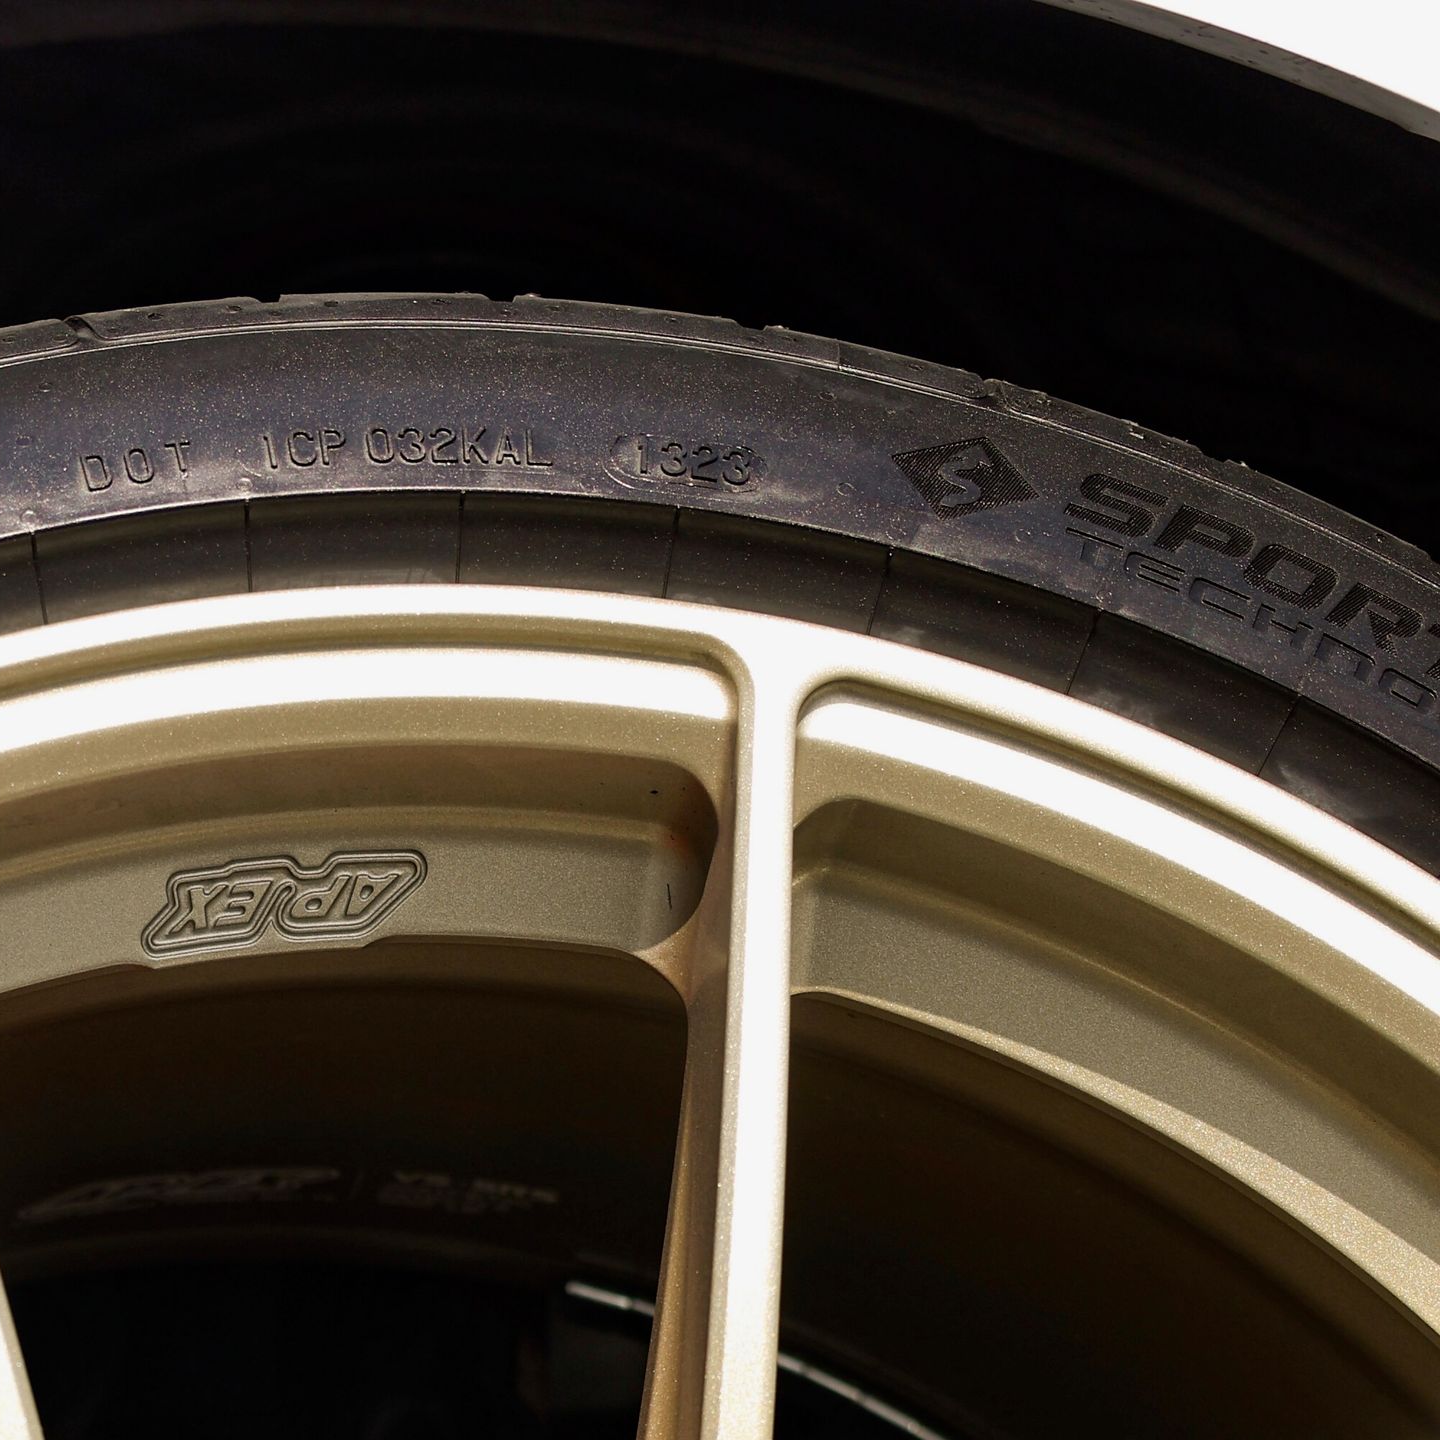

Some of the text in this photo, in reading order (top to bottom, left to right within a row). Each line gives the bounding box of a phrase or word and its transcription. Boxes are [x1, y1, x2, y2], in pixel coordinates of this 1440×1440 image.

[78, 439, 192, 493] DOT
[261, 428, 349, 471] 1CP
[635, 432, 755, 488] 1323
[1063, 472, 1440, 684] SPOR
